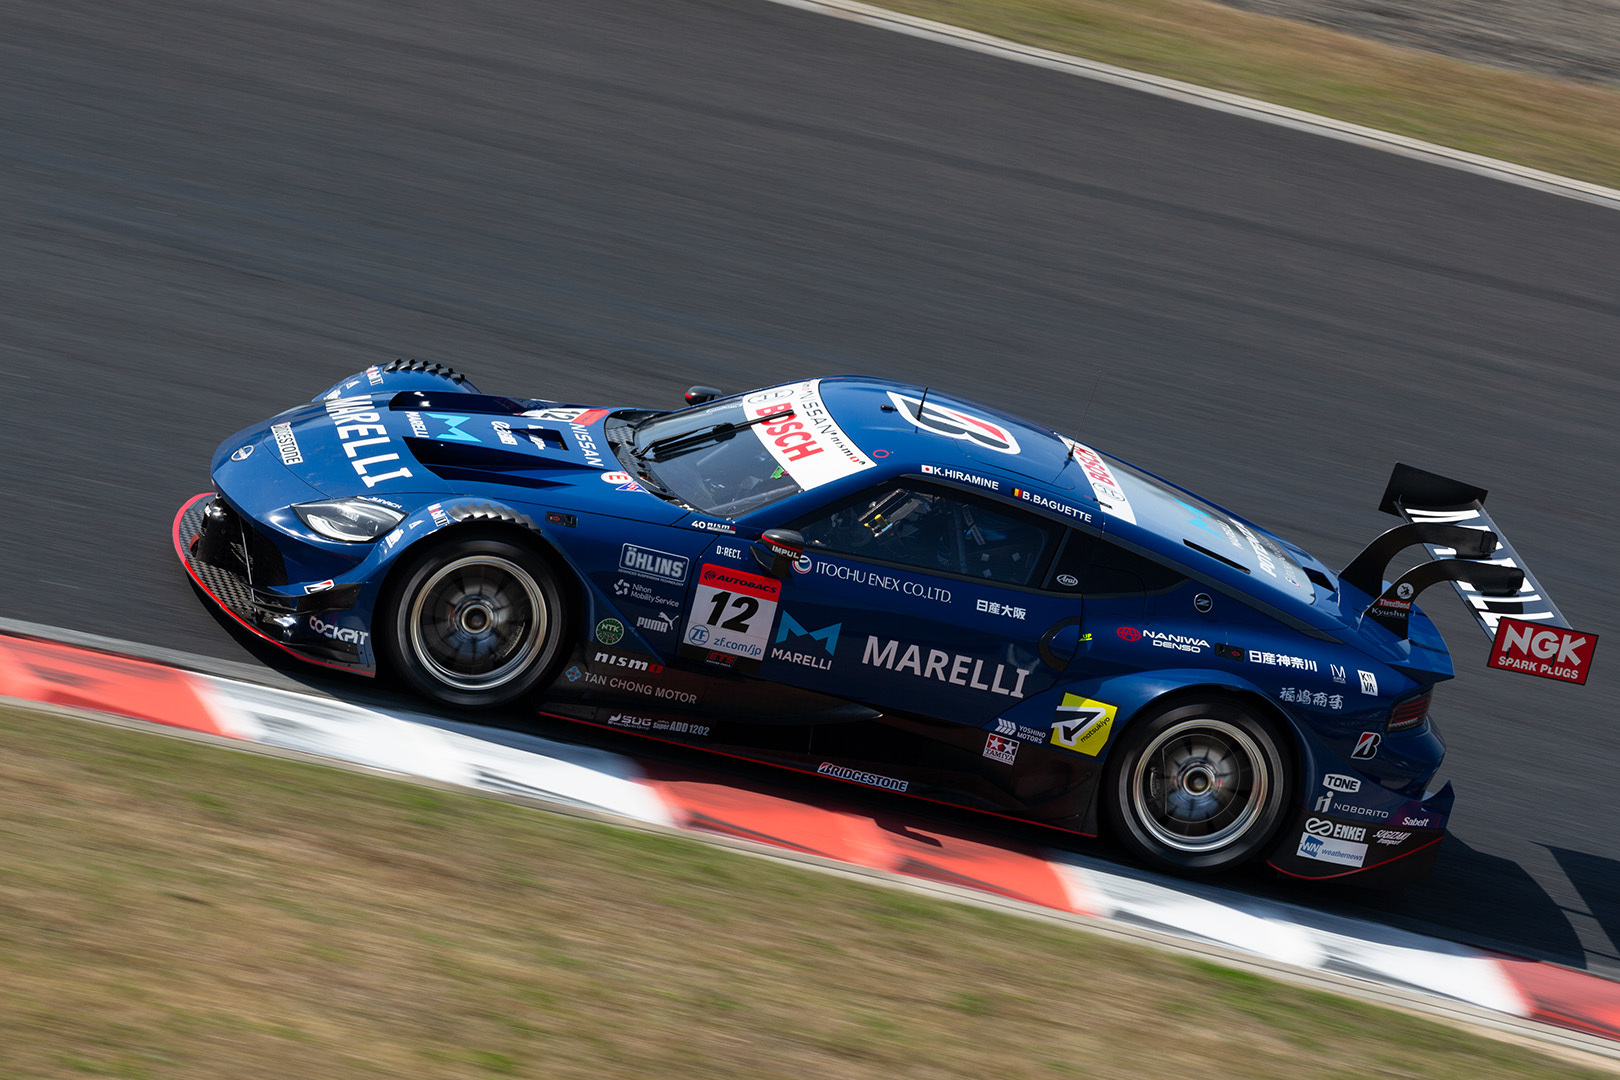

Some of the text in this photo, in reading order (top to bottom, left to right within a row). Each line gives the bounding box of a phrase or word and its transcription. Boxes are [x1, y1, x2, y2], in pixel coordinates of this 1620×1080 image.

[799, 390, 837, 434] NISSAN
[271, 423, 302, 464] ESTONE
[325, 394, 413, 488] MARELLI
[755, 402, 824, 463] BOSCH
[569, 422, 604, 467] NISSAN
[933, 466, 1000, 491] K.HIRAMINE
[1022, 490, 1092, 523] B.BAGUETTE
[691, 520, 706, 529] 40
[624, 546, 684, 578] ÖHLINS
[771, 546, 800, 560] IMPUL
[717, 574, 778, 595] AUTOBACS
[816, 561, 866, 584] ITOCHU
[868, 573, 900, 592] ENEX
[632, 583, 652, 594] Nihon
[706, 591, 760, 634] 12
[976, 599, 1027, 621] 日産大阪
[1371, 607, 1406, 618] Kyushu
[309, 615, 368, 645] COCKPIT
[601, 623, 620, 632] NTK
[636, 616, 668, 633] PUMA
[713, 636, 762, 656] zf.com/jp
[1143, 629, 1211, 648] NANIWA
[1152, 639, 1201, 654] DENSO
[1501, 624, 1587, 667] NGK
[771, 647, 832, 671] MARELLI
[861, 634, 1030, 699] MARELLI
[1248, 649, 1318, 672] 日産神奈川
[1498, 655, 1579, 680] SPARK PLUGS
[585, 672, 697, 705] TAN CHONG MOTOR
[1017, 732, 1043, 744] MOTORS
[1019, 725, 1046, 738] YOSHINO
[1080, 716, 1111, 743] matsukiyo
[985, 748, 1014, 762] TAMIYA
[818, 763, 908, 792] BRIDGESTONE
[1327, 776, 1359, 791] TONE
[1333, 803, 1389, 819] NOBORITO
[1333, 824, 1366, 842] ENKEI
[1321, 848, 1363, 862] weathernews
